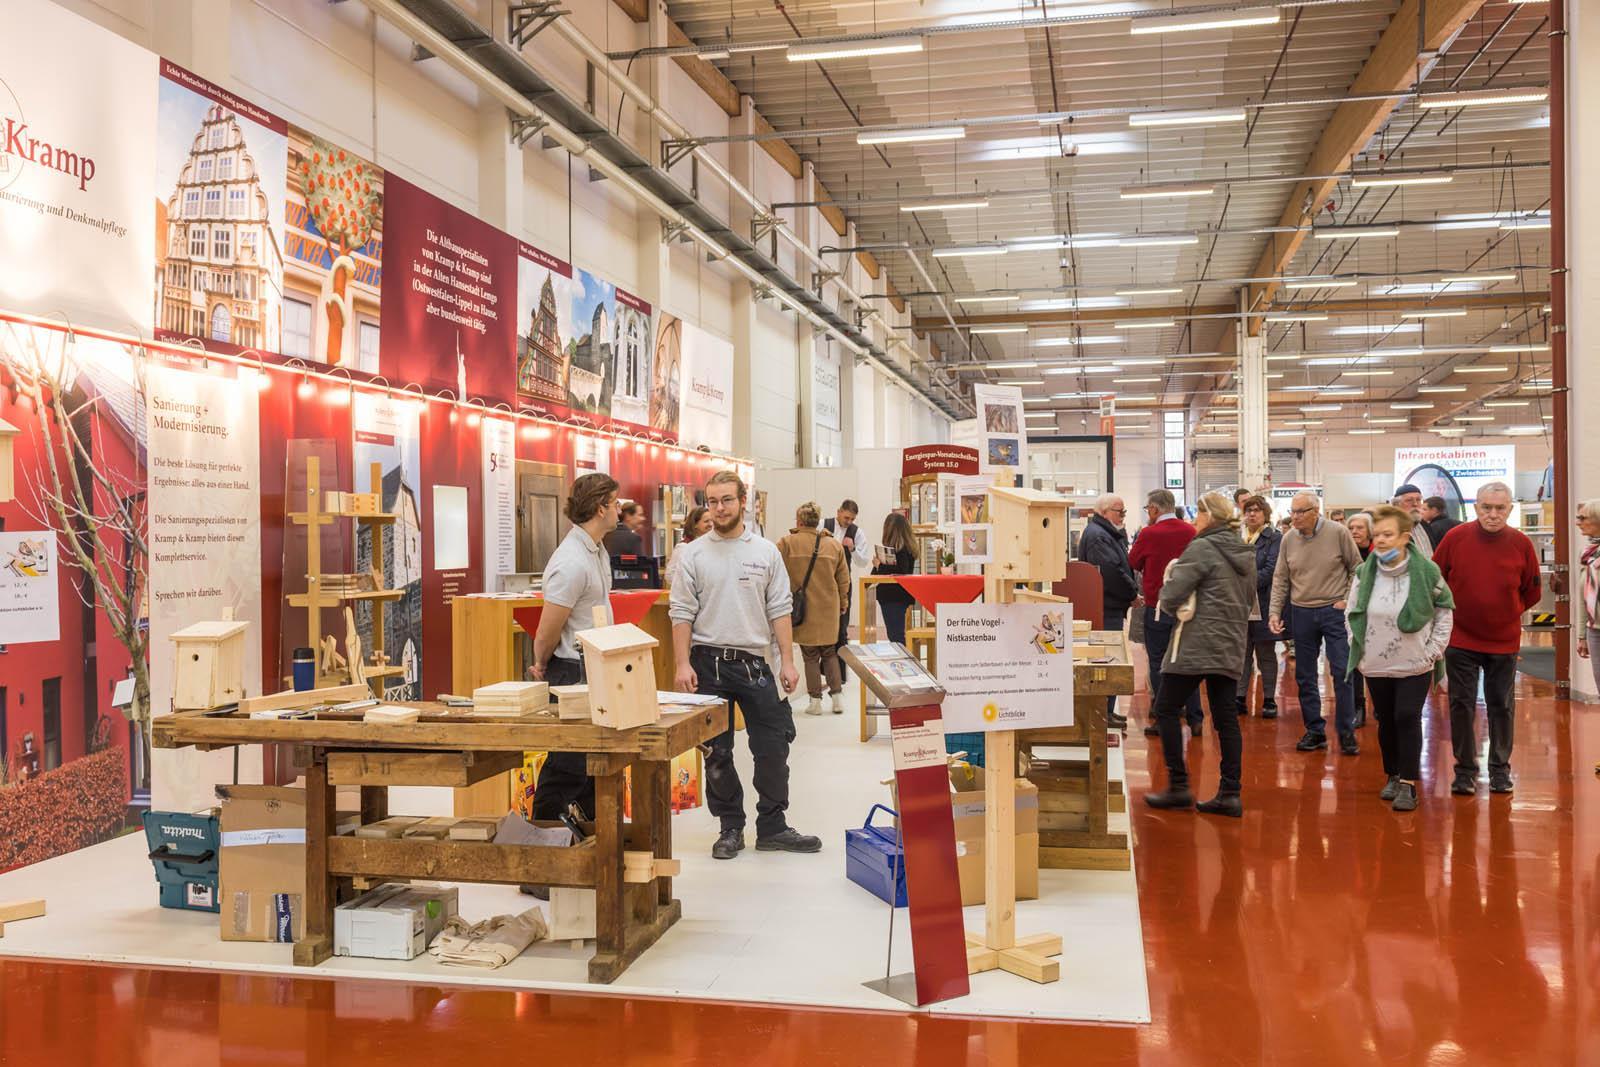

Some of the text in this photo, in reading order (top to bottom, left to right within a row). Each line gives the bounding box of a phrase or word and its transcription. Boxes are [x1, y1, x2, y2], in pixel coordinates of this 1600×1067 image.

[4, 117, 95, 192] Kramp
[47, 205, 64, 217] und
[66, 208, 127, 238] Denkmalpflege
[427, 229, 488, 267] Die Altbauspezialisten
[422, 248, 491, 285] von Kramp & Kramp sind
[414, 260, 497, 305] in der Alten Hansestadt Lemgo
[412, 278, 473, 311] (Ostwestfalen-Lippe)
[481, 304, 498, 320] Hause,
[427, 302, 440, 316] aber
[441, 307, 472, 328] bundesweit
[153, 396, 201, 418] Sanierung
[154, 416, 228, 439] Modernisierung.
[905, 451, 978, 462] Energiespar-Vorsatzscheiben
[1398, 450, 1486, 459] Infrarotkabinen
[154, 457, 242, 472] Die beste Lösung für perfekte
[924, 461, 945, 469] System
[155, 514, 166, 524] Die
[168, 514, 236, 526] Sanierungsspezialisten
[155, 533, 245, 544] Kramp & Kramp bieten diesen
[155, 552, 207, 564] Komplettservice.
[156, 588, 223, 602] Sprechen wir darüber.
[947, 618, 959, 627] Der
[961, 618, 979, 626] frühe
[981, 618, 1000, 628] Vogel
[947, 634, 996, 642] Nistkastenbau
[161, 826, 205, 840] makita
